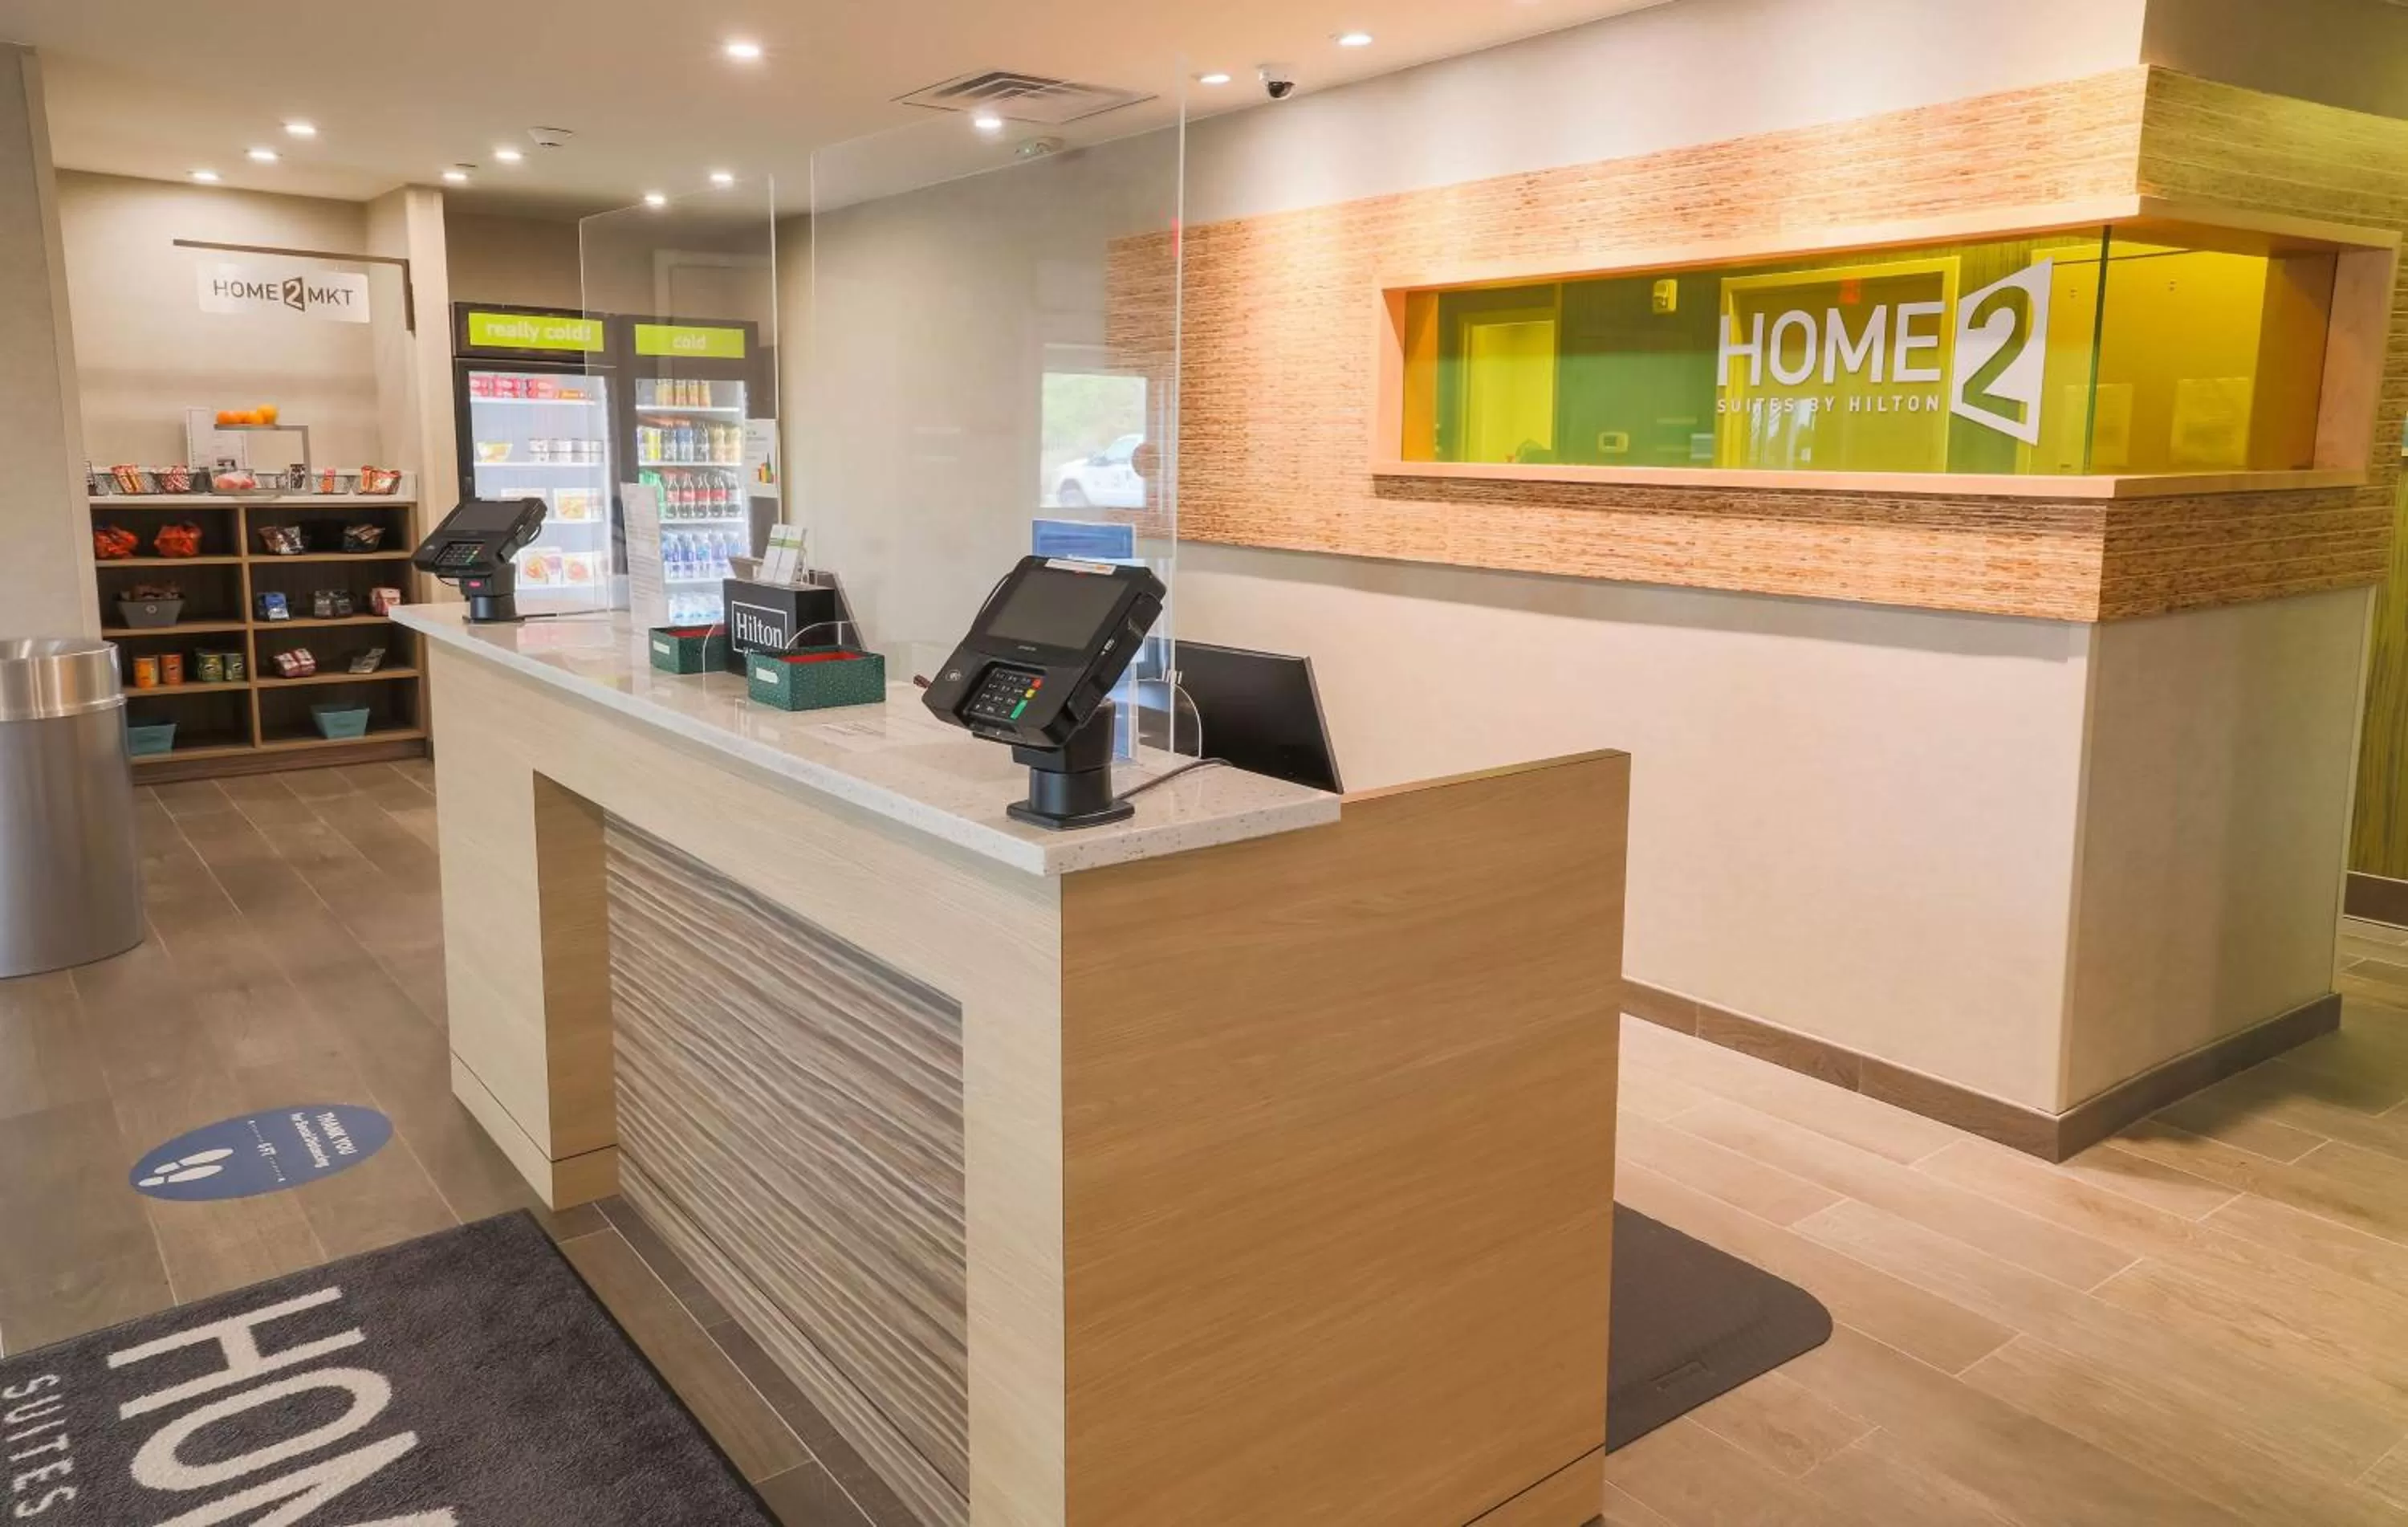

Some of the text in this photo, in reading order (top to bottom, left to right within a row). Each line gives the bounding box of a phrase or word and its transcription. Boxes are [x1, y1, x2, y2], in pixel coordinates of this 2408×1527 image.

[213, 279, 280, 301] HOME
[307, 287, 354, 306] MKT
[486, 321, 539, 342] really
[673, 333, 706, 350] cold
[1717, 281, 2039, 427] HOME 2
[1717, 393, 1941, 414] SUITES BY HILTON
[736, 612, 783, 649] Hilton
[2, 1374, 77, 1519] SUITES
